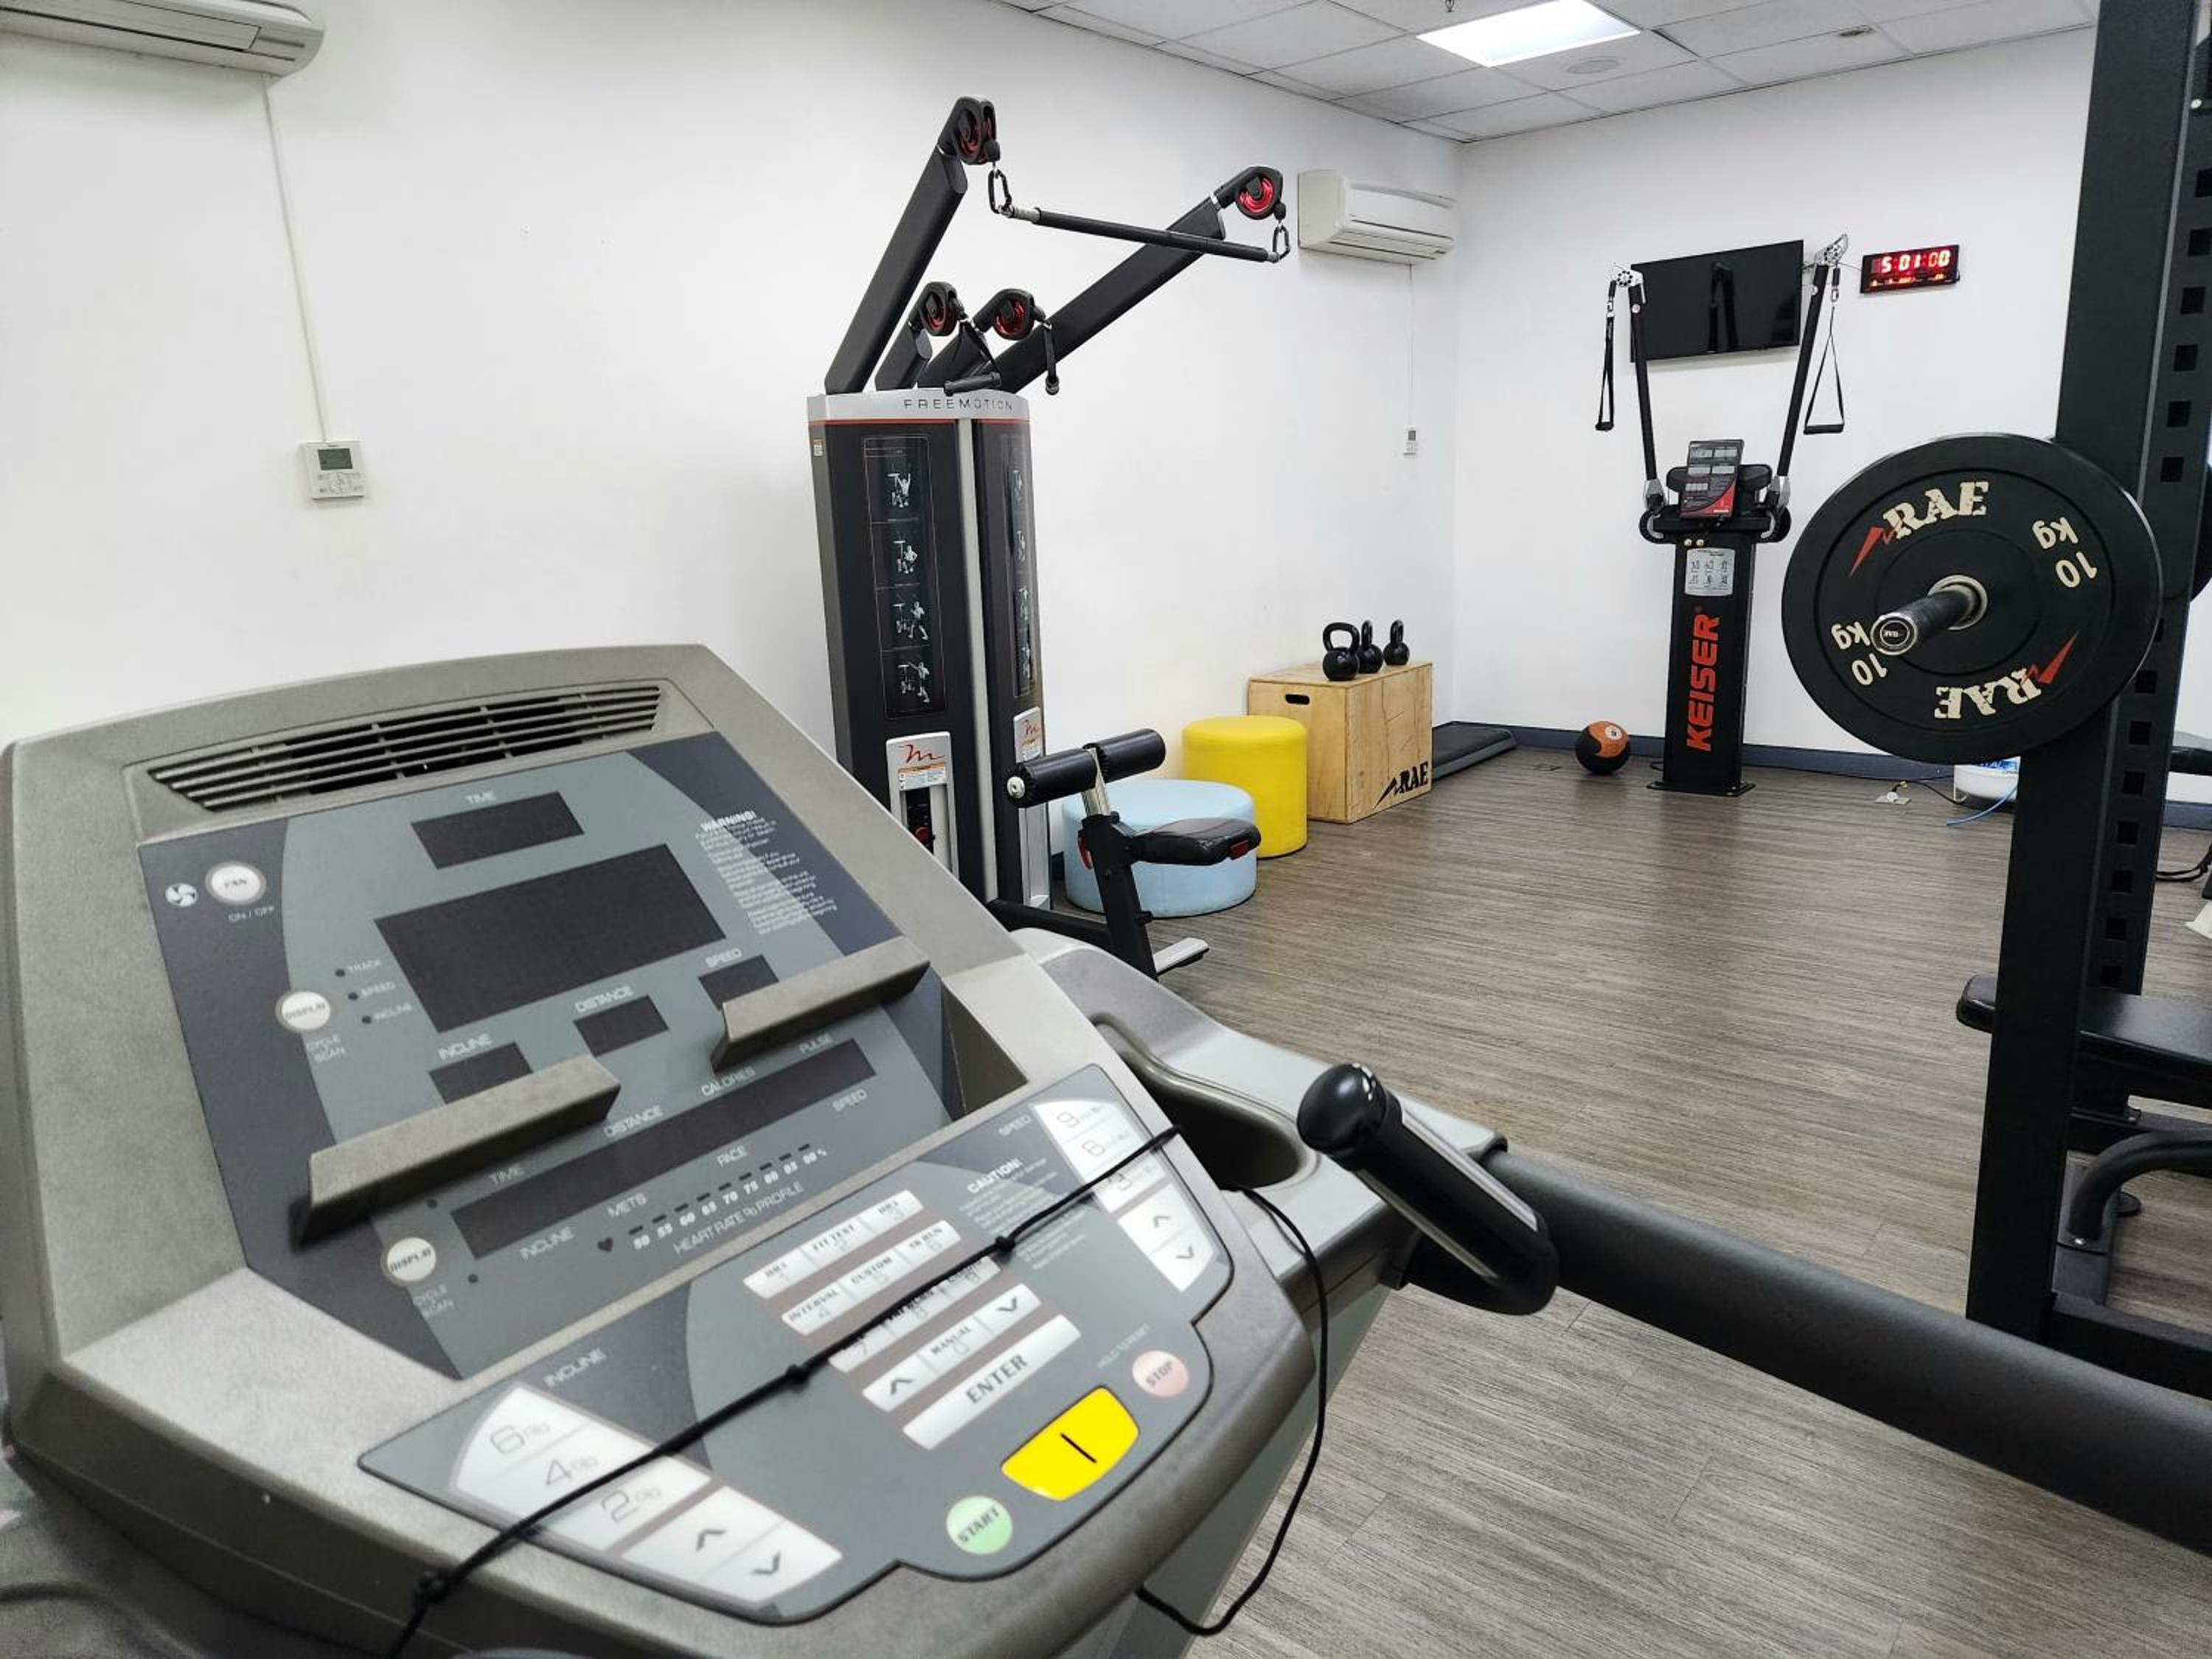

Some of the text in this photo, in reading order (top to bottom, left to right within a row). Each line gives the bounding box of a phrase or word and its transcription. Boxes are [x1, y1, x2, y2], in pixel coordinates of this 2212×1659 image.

[1881, 249, 1951, 274] 5:01:00
[903, 398, 1013, 411] FREEMOTION
[1882, 481, 1989, 540] RAE
[2031, 517, 2079, 549] kg
[2056, 552, 2098, 588] 10
[1831, 621, 1871, 650] kg
[1686, 613, 1720, 752] KEISER
[1851, 653, 1888, 686] 10
[1934, 668, 2042, 720] RAE
[1399, 761, 1429, 796] RAE
[465, 791, 495, 804] TIME
[700, 810, 757, 832] WARNING!
[706, 948, 742, 967] SPEED
[575, 986, 633, 1013] DISTANCE
[438, 1034, 493, 1060] INCLINE
[799, 1034, 834, 1053] PULSE
[701, 1066, 756, 1097] CALORIES
[832, 1089, 868, 1112] SPEED
[604, 1105, 664, 1138] DISTANCE
[717, 1145, 748, 1167] PACE
[967, 1158, 1023, 1194] CAUTION!
[607, 1192, 647, 1217] METS
[723, 1191, 738, 1206] 70
[743, 1180, 759, 1195] 75
[673, 1225, 714, 1253] HEART
[714, 1211, 746, 1234] RATE
[757, 1181, 804, 1212] PROFILE
[520, 1226, 575, 1262] INCLINE
[851, 1256, 893, 1285] CUSTOM
[546, 1347, 607, 1387] INCLINE
[966, 1354, 1027, 1404] ENTER
[1146, 1360, 1173, 1387] STOP
[956, 1505, 1001, 1543] START
